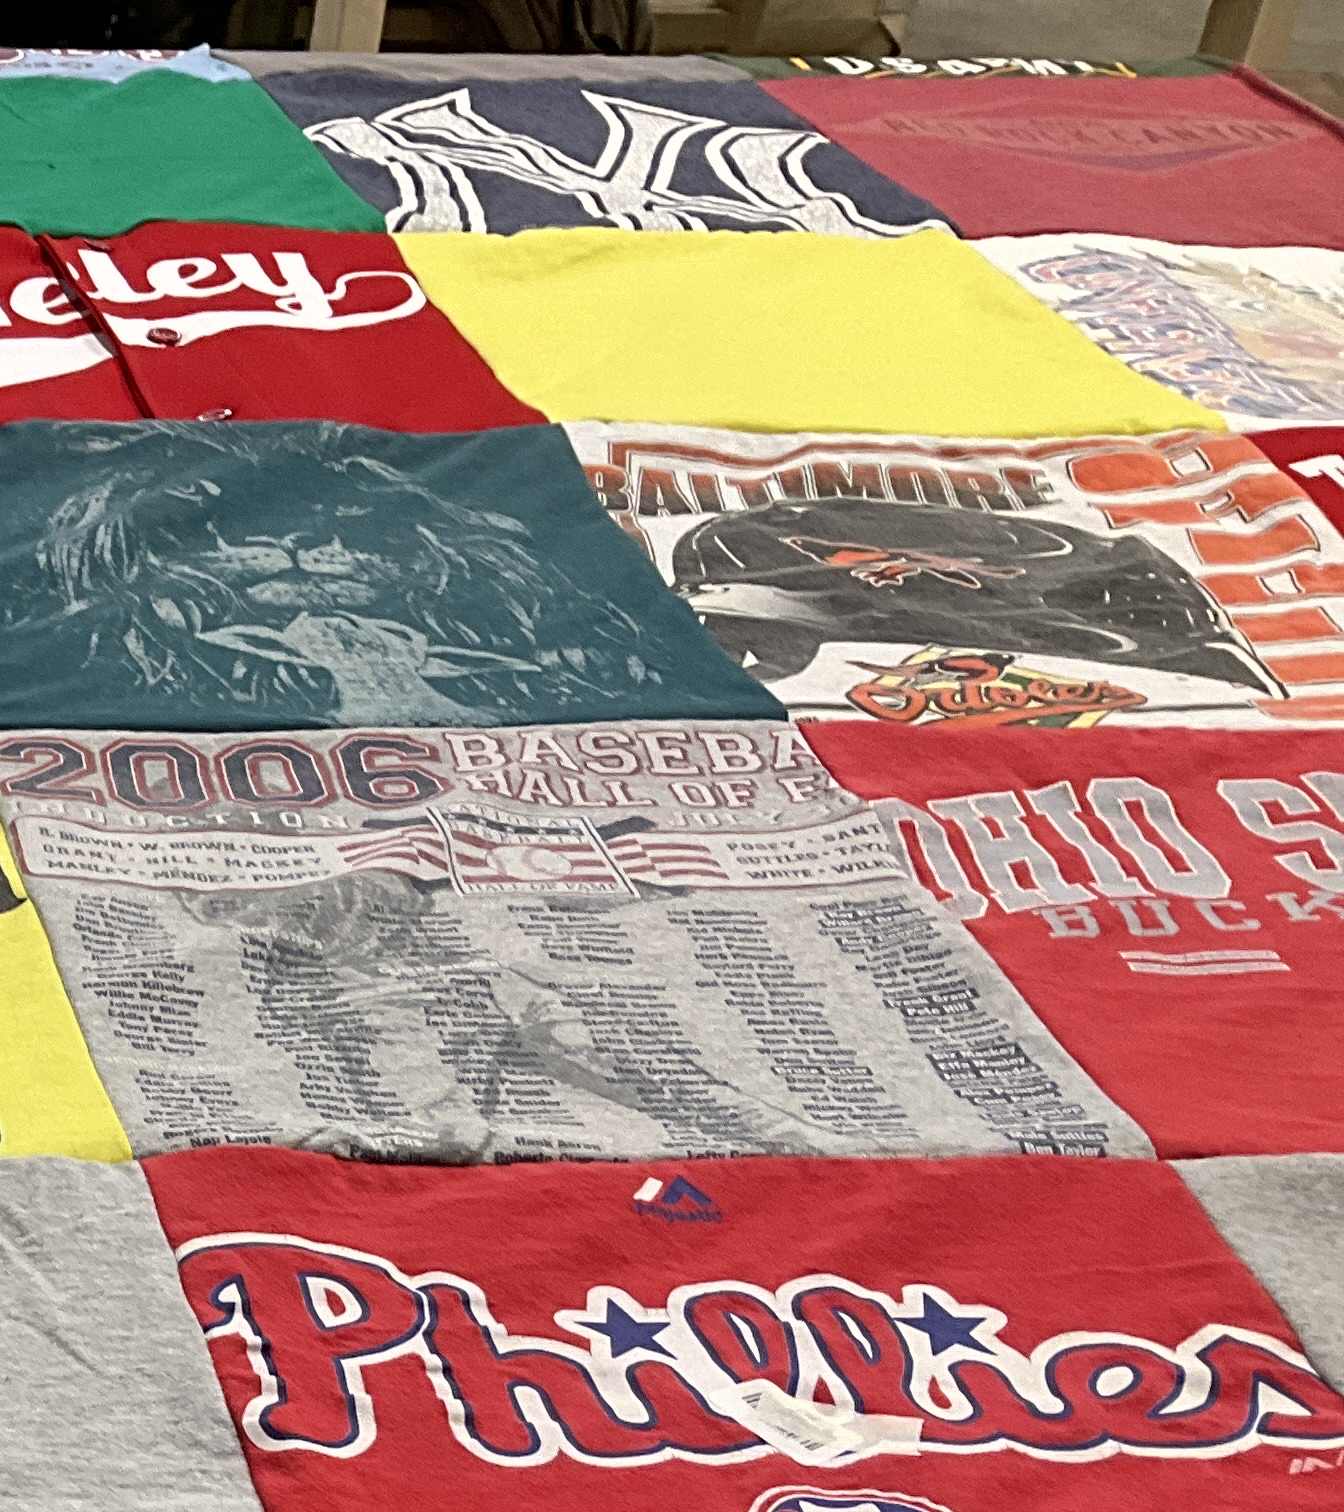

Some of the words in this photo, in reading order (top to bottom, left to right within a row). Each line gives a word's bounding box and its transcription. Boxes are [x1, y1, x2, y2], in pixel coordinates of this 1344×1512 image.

[586, 459, 1064, 514] BALTIMORE
[461, 766, 660, 807] HALL
[669, 777, 757, 808] OF
[173, 1231, 1344, 1467] Phillies
